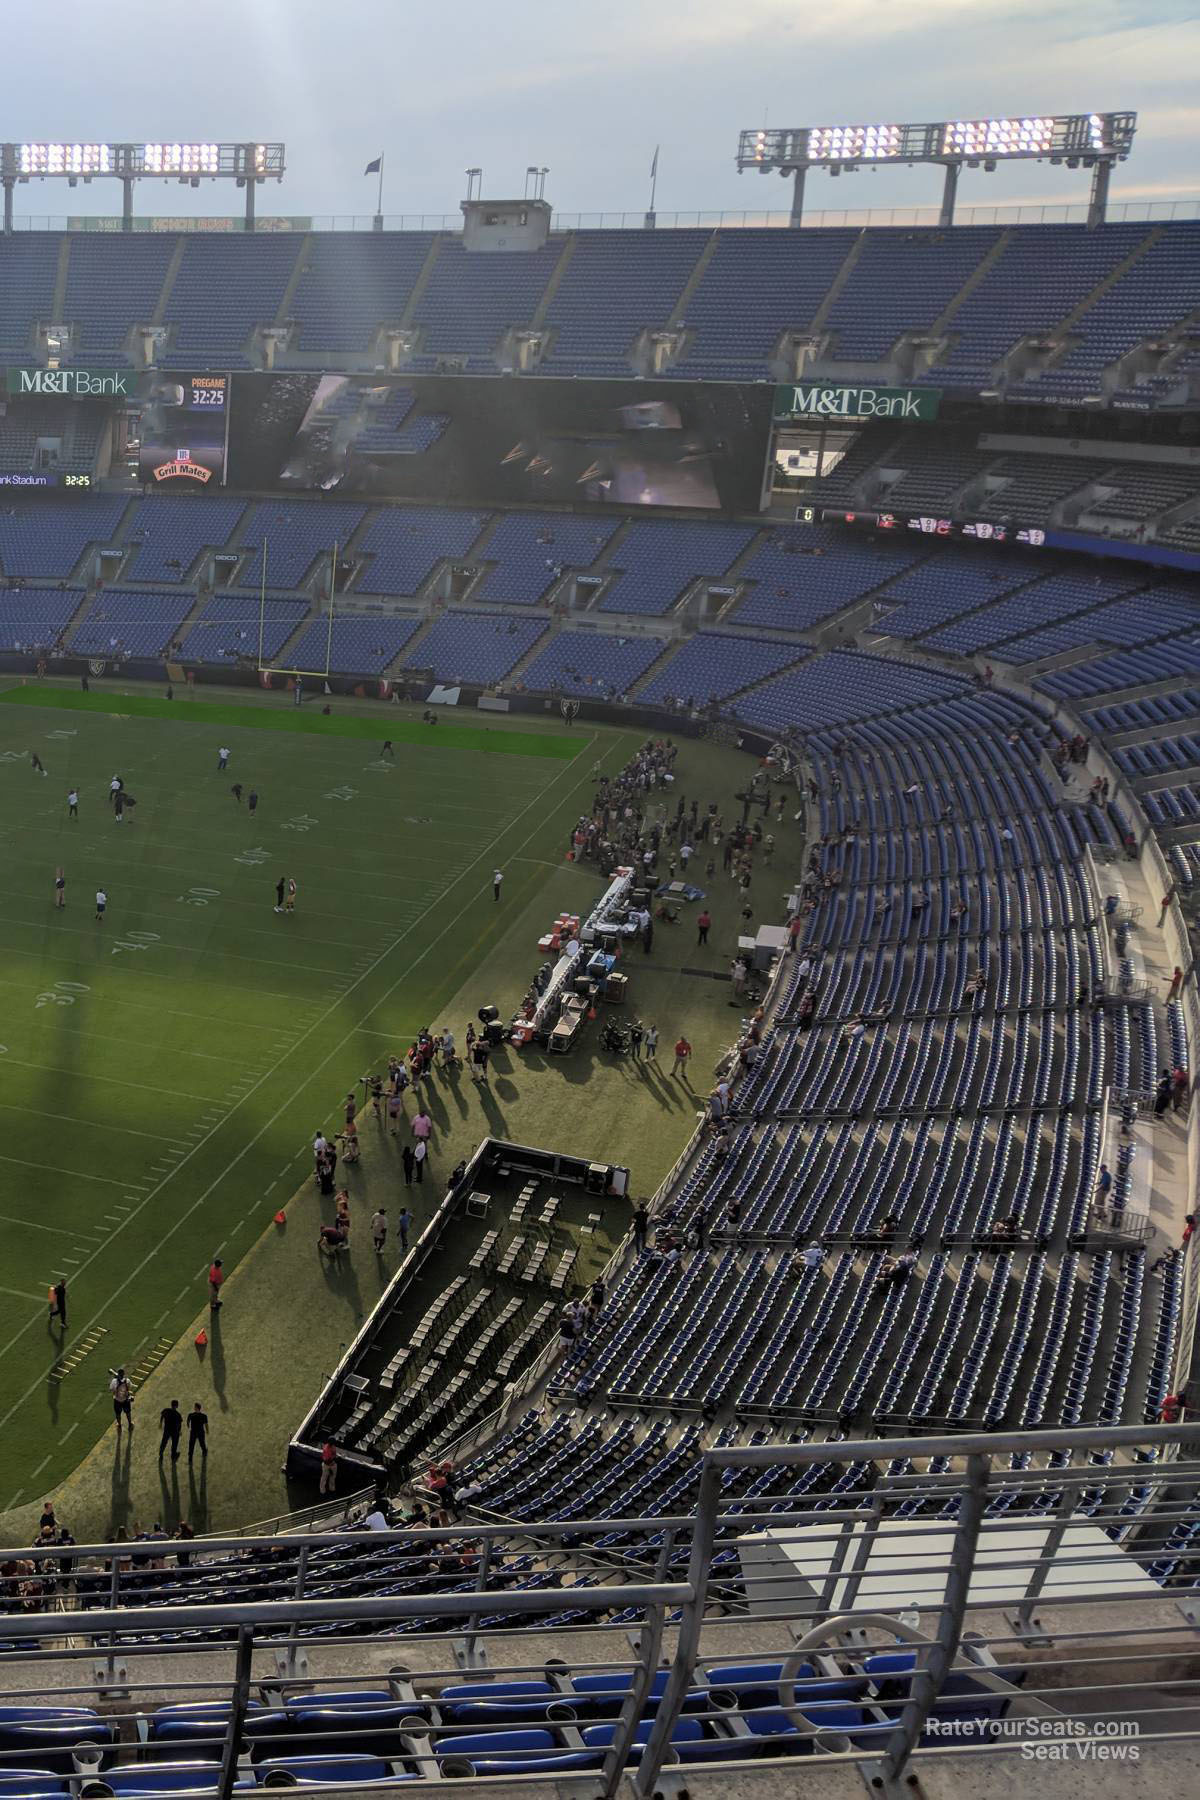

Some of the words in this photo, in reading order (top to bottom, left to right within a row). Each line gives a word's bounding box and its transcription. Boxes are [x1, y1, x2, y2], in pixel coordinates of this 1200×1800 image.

[19, 370, 74, 394] M&T
[76, 371, 127, 394] Bank
[191, 378, 226, 389] PREGAME
[192, 389, 224, 405] 32:25
[790, 387, 857, 414] M&T
[857, 389, 921, 417] Bank
[158, 466, 177, 478] Grill
[180, 465, 207, 479] Mates
[11, 474, 47, 485] Stadium
[65, 475, 90, 486] 32:25
[804, 508, 813, 521] 0
[36, 981, 91, 1007] 30
